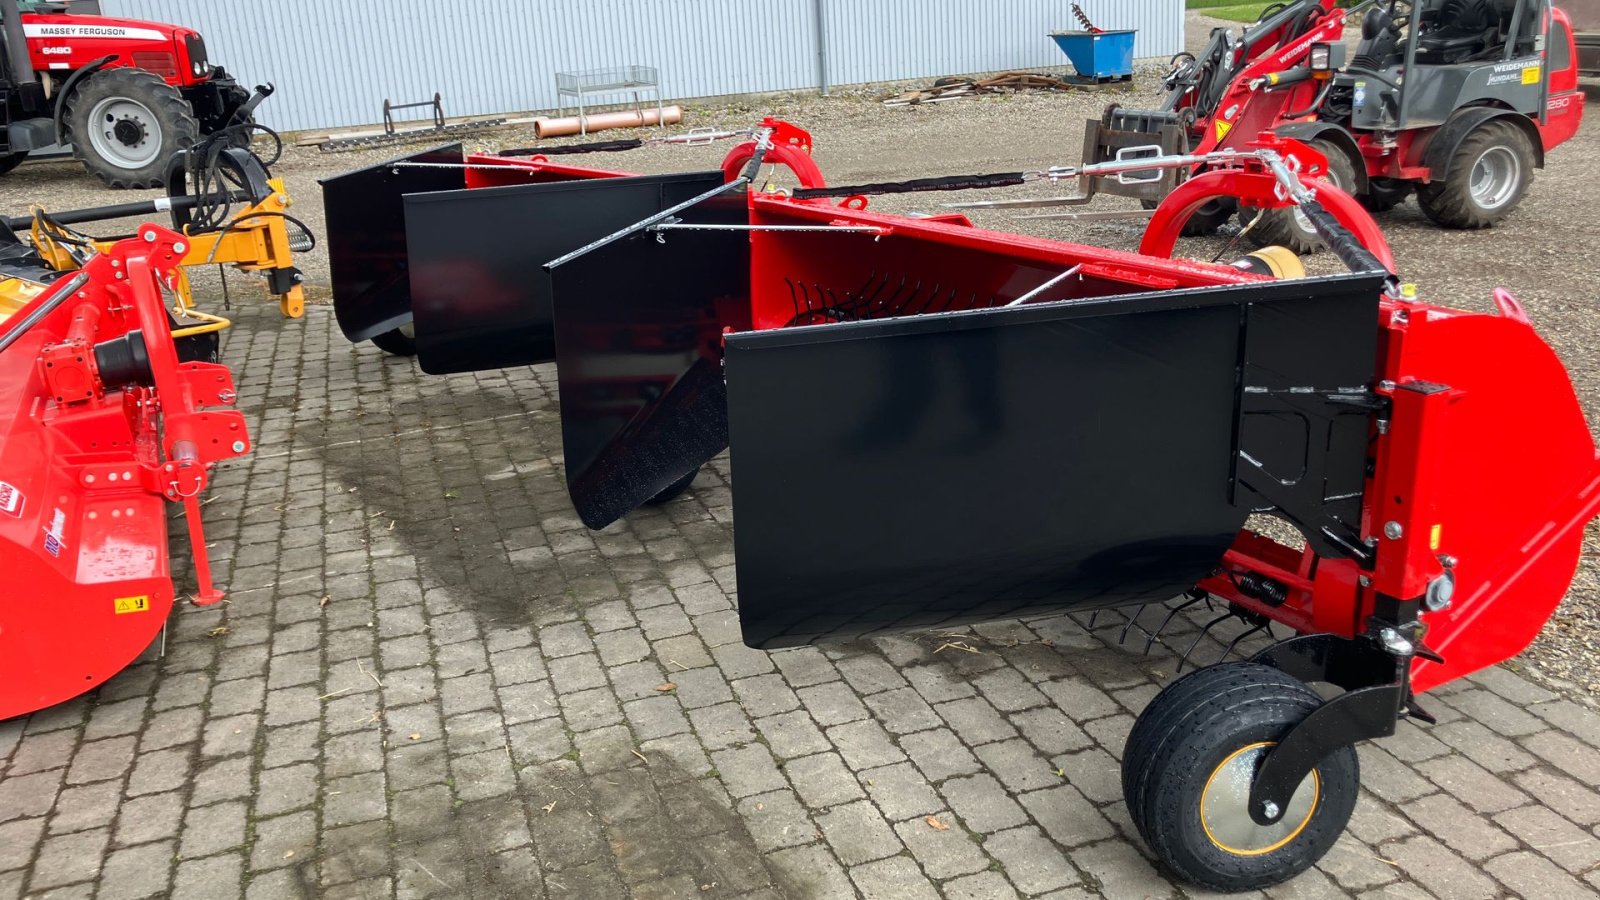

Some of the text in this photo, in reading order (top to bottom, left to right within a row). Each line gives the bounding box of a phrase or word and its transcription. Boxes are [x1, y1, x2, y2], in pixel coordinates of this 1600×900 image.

[79, 28, 125, 36] FERGUSON
[42, 46, 72, 54] 6480
[1278, 31, 1324, 63] WEIDEMANN
[1493, 60, 1541, 73] WEIDEMANN
